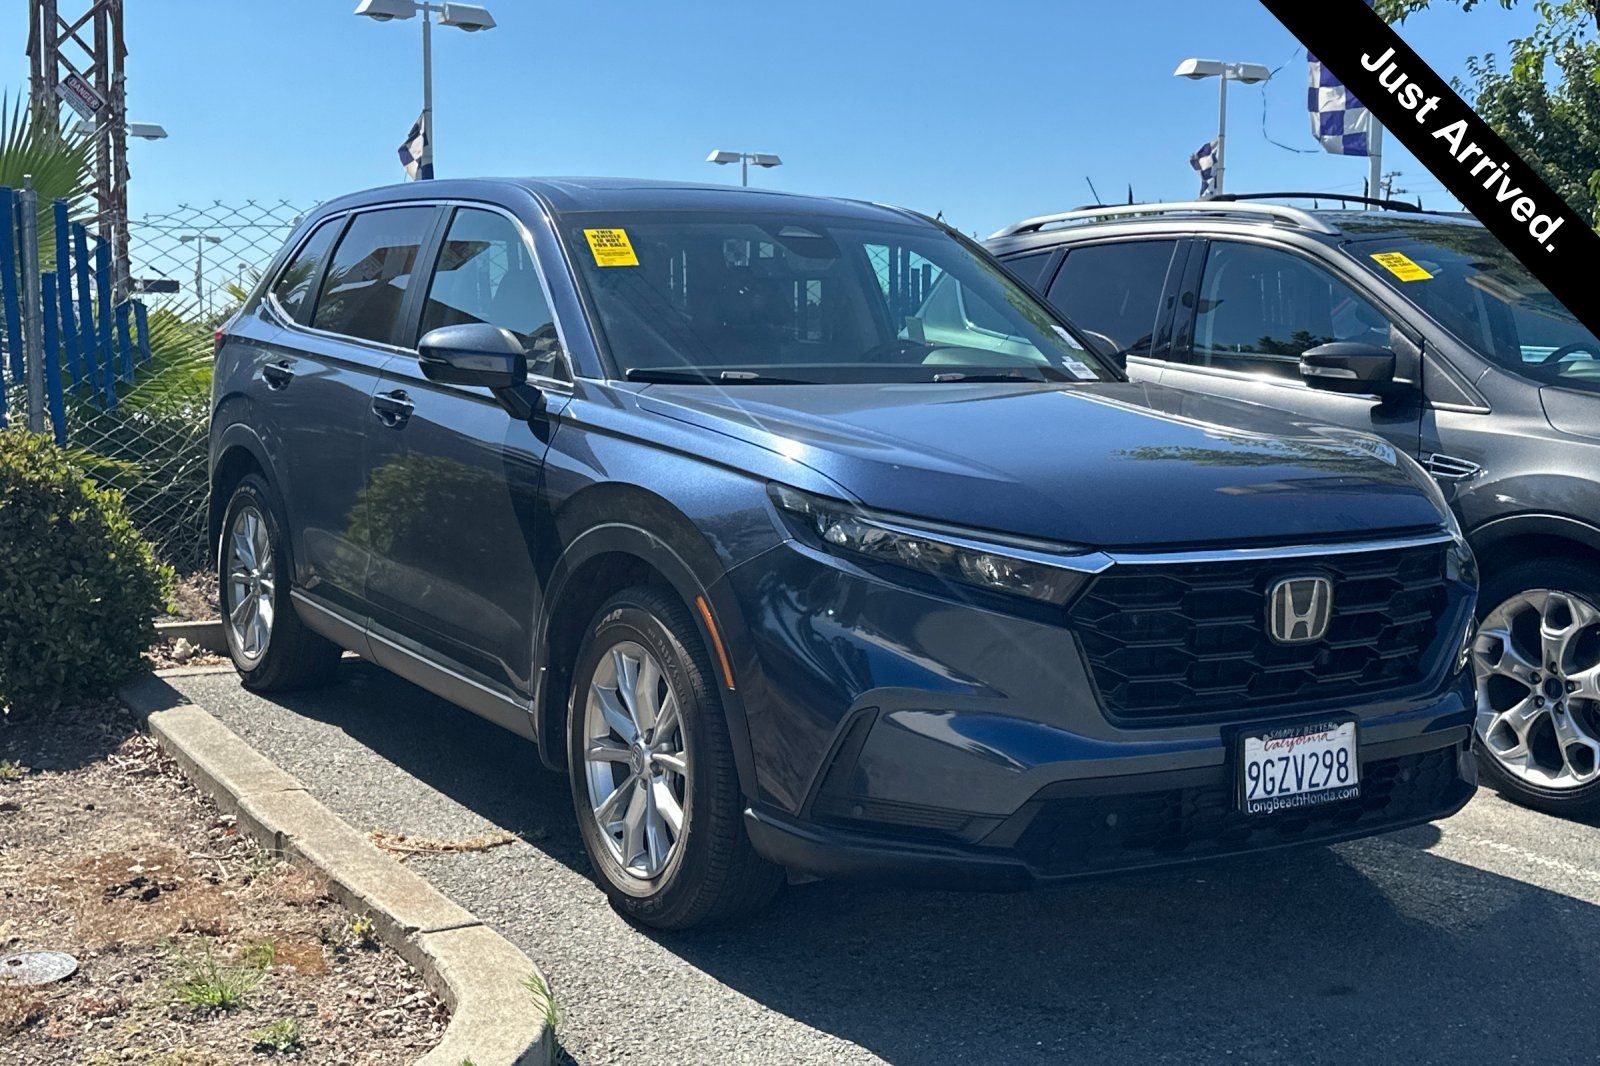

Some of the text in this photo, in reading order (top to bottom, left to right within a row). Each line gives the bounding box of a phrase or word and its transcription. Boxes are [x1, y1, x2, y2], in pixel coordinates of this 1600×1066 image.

[69, 78, 98, 107] DANGER
[1304, 721, 1334, 735] BETTER
[1263, 731, 1335, 753] California
[1246, 747, 1349, 800] 9GZV298
[1246, 787, 1359, 814] LongBeachHonda.com
